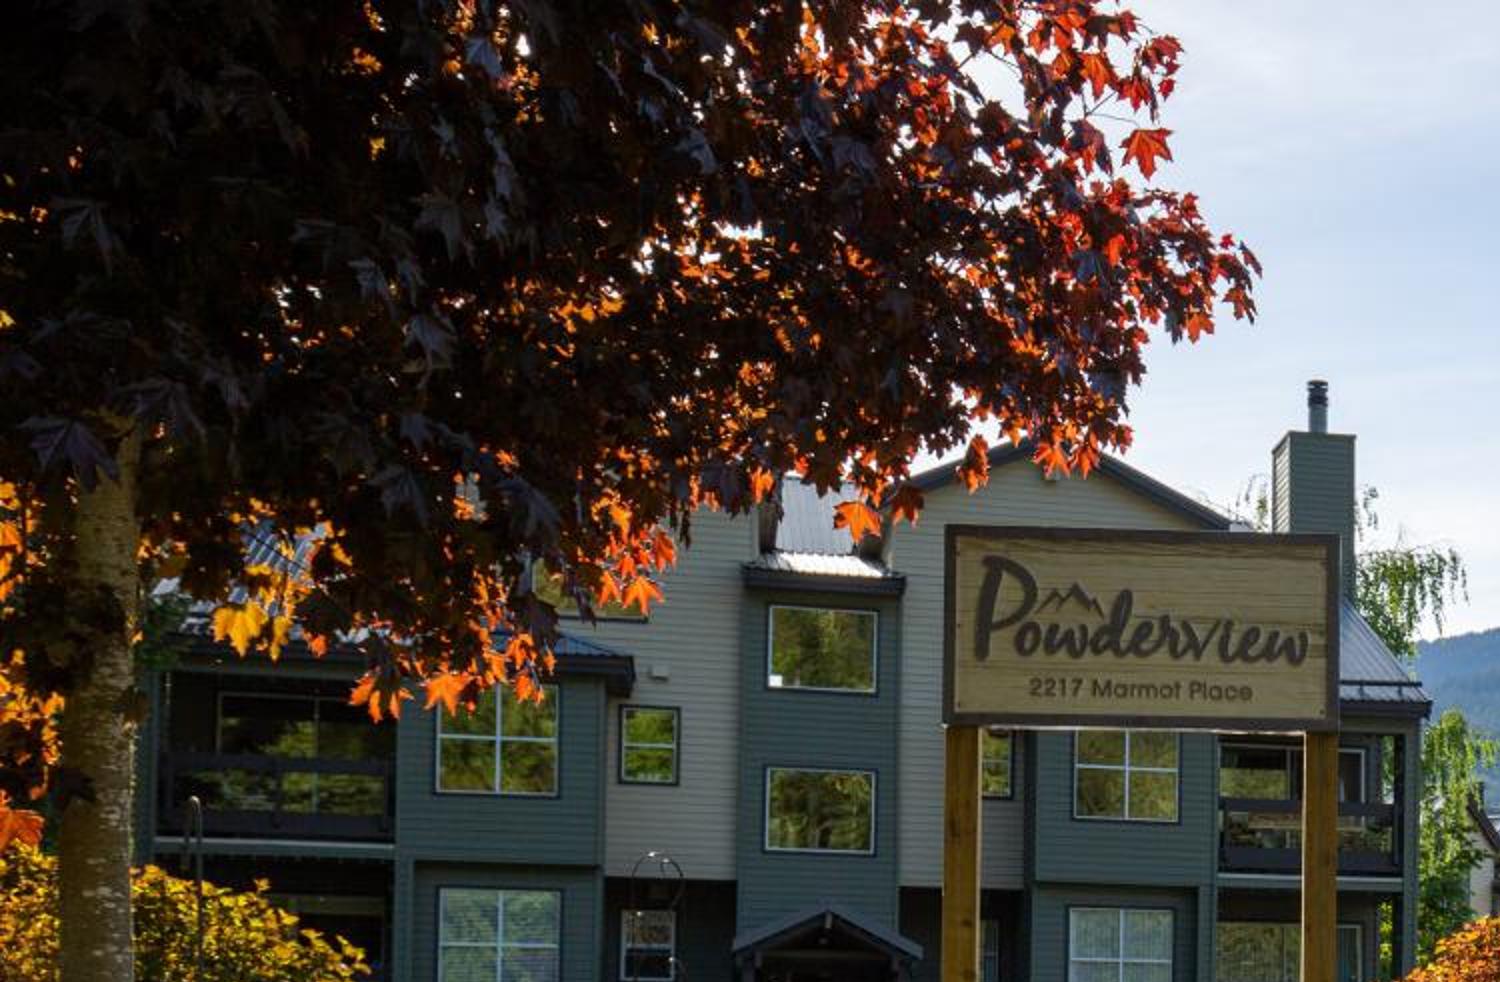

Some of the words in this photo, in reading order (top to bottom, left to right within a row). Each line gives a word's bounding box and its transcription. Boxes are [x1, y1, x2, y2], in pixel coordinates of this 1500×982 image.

[975, 555, 1310, 666] Powderview
[1029, 678, 1081, 698] 2217
[1091, 679, 1182, 700] Marmot
[1190, 682, 1254, 702] Place
